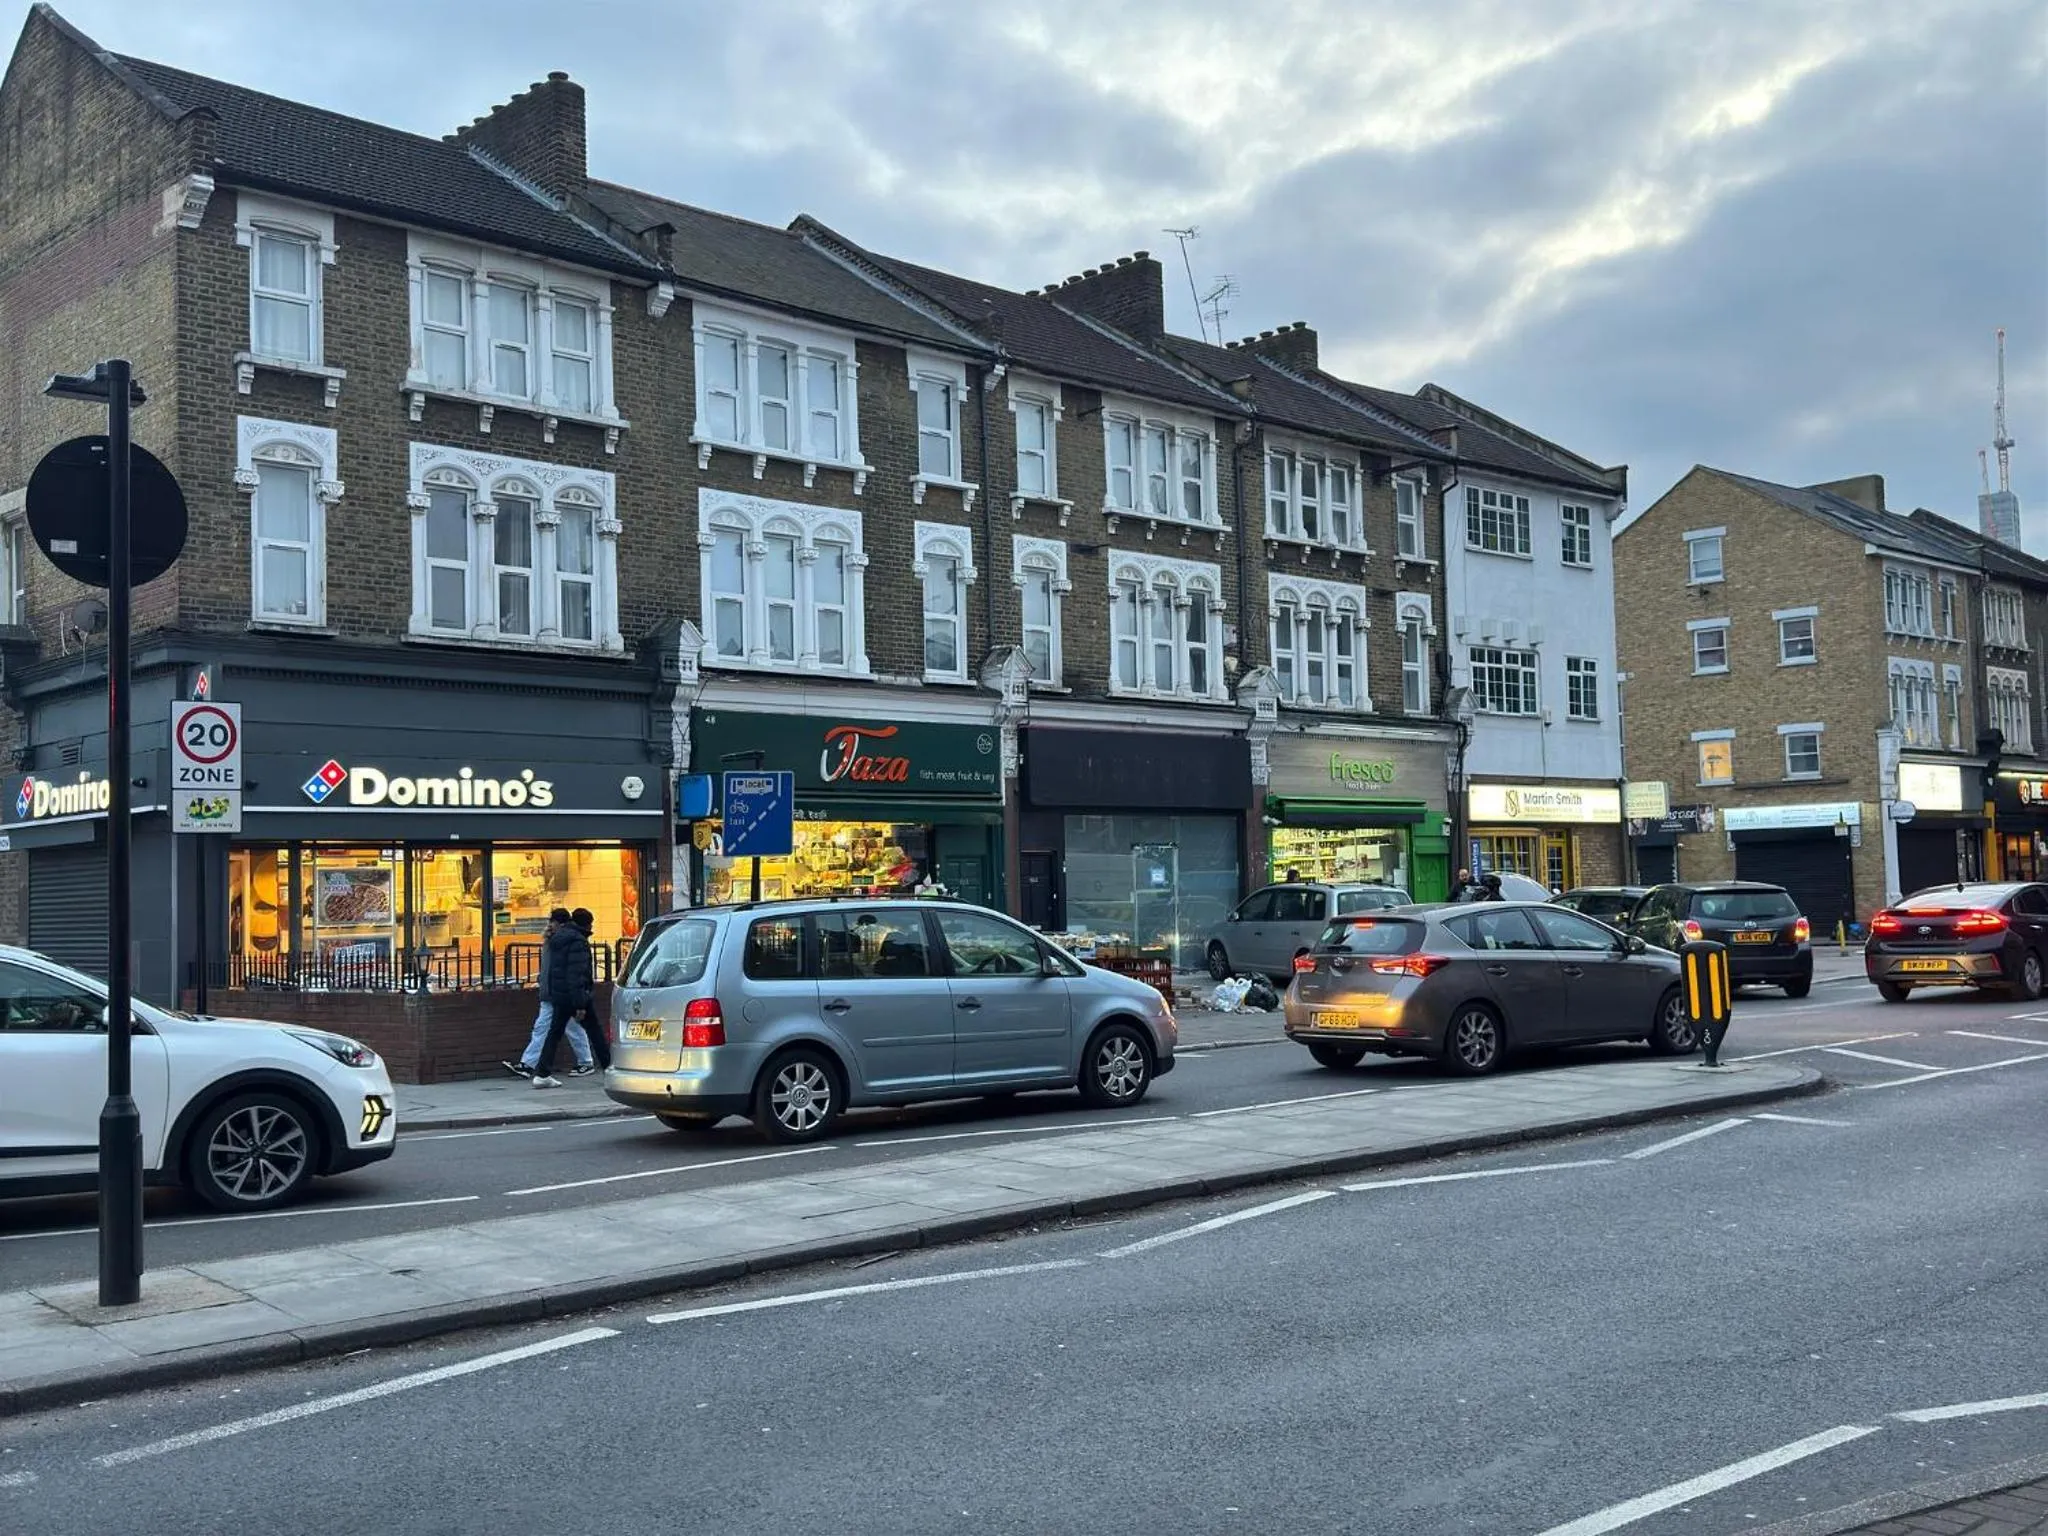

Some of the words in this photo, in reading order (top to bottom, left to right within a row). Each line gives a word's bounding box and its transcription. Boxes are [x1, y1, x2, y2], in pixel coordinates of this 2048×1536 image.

[187, 723, 229, 747] 20
[820, 724, 910, 783] Taza
[180, 767, 235, 782] ZONE
[745, 779, 766, 788] local
[33, 771, 110, 818] Domino
[350, 766, 554, 808] Domino's
[1523, 791, 1554, 805] Martin
[1556, 791, 1583, 806] Smith
[729, 817, 745, 825] taxi
